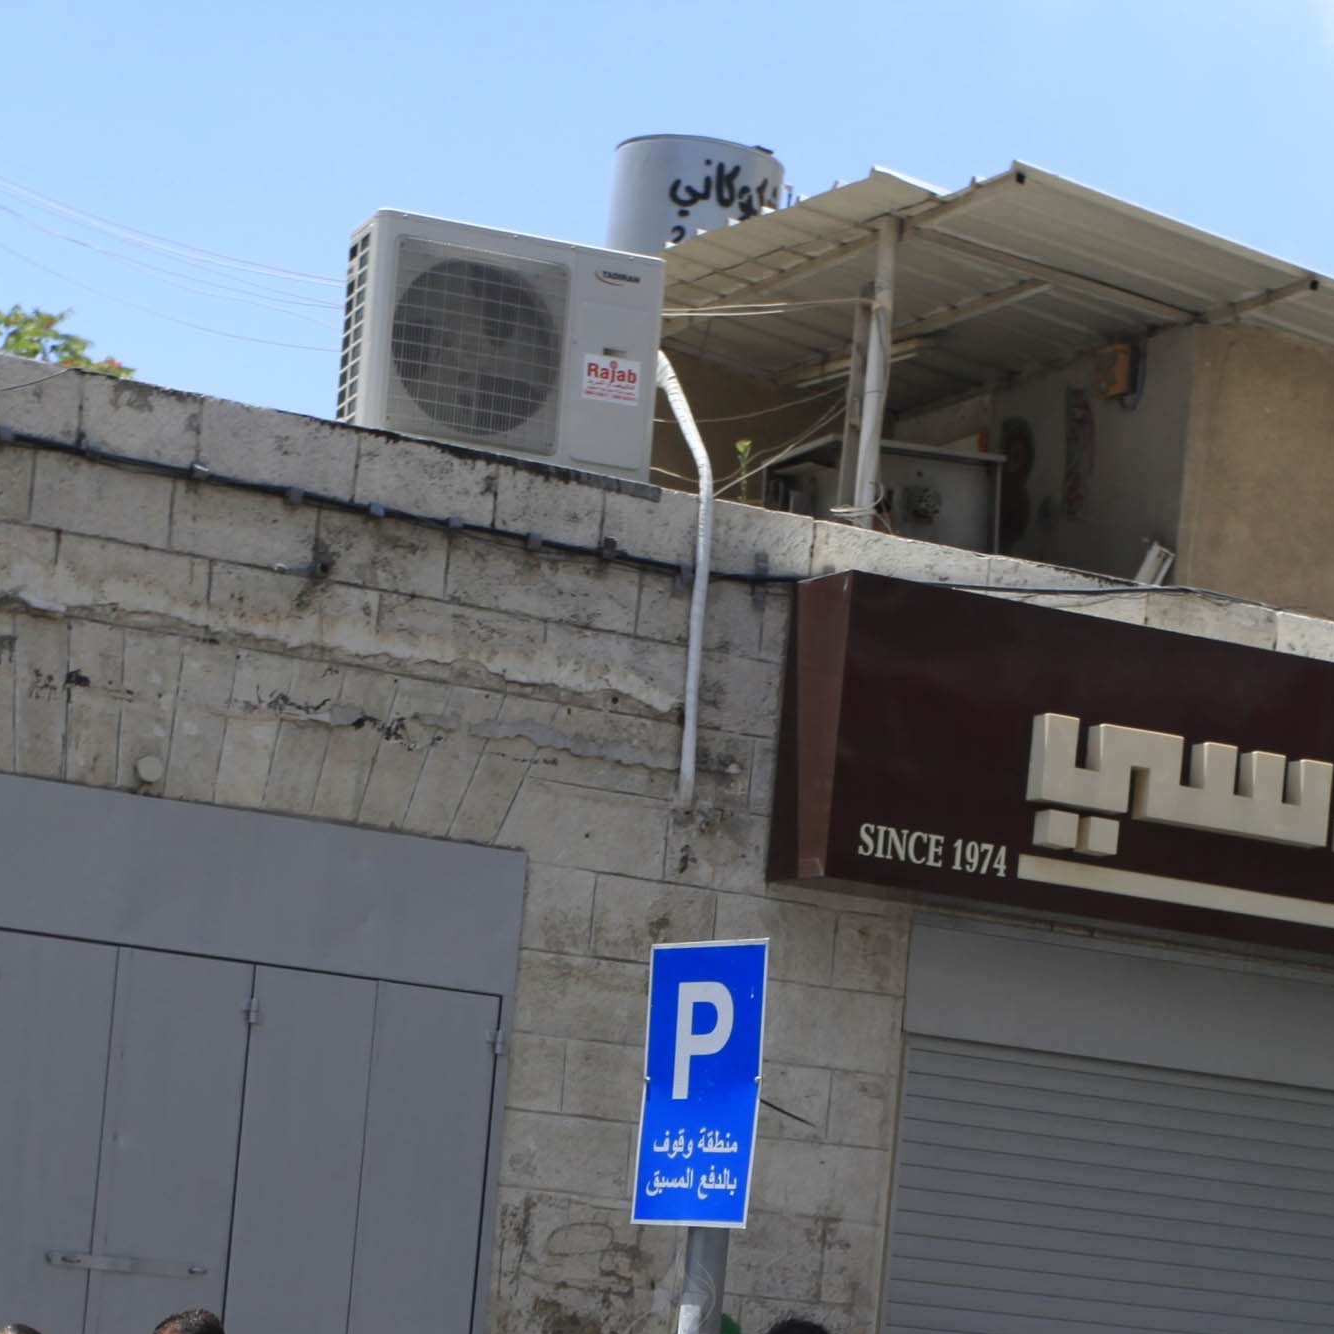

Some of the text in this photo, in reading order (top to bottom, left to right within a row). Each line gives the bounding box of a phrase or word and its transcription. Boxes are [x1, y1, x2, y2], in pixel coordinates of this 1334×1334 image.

[586, 360, 637, 385] Rajab
[857, 822, 1008, 878] SINCE 1974
[671, 980, 735, 1100] P
[652, 1126, 739, 1159] منطقة وقوف
[645, 1164, 738, 1200] بالدفع المسبق
